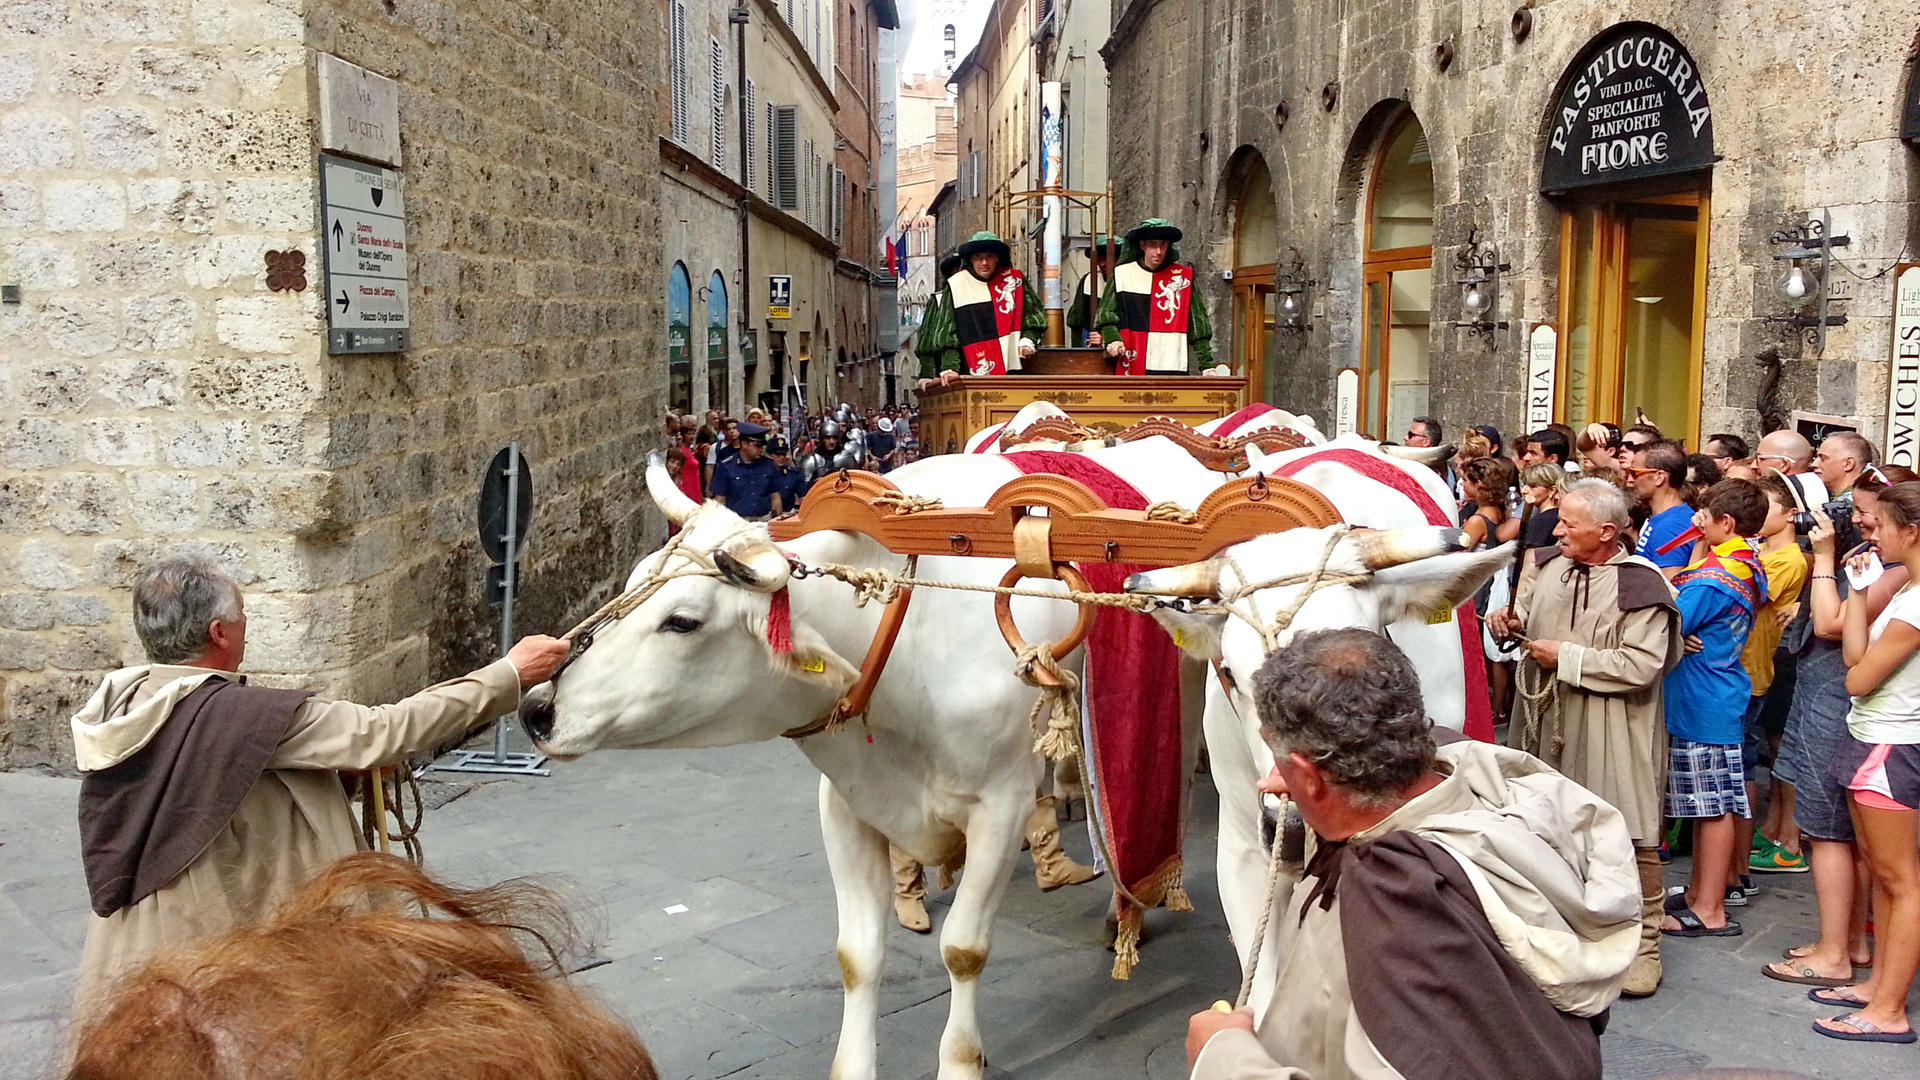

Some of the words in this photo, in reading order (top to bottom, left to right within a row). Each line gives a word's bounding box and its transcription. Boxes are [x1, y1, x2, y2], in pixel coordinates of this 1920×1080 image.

[357, 86, 372, 105] VIA
[1551, 36, 1710, 156] PASTICCERIA
[1600, 83, 1622, 100] VINI
[1624, 76, 1656, 95] D.O.C.
[1587, 91, 1667, 122] SPECIALITA'
[348, 116, 357, 133] DI
[1591, 112, 1661, 139] PANFORTE
[1581, 131, 1669, 175] FIORE
[355, 172, 376, 186] COMUNE
[357, 222, 372, 233] Duomo
[358, 248, 371, 258] Museo
[366, 262, 381, 272] Duomo
[359, 285, 373, 295] Piazza
[773, 278, 787, 297] T
